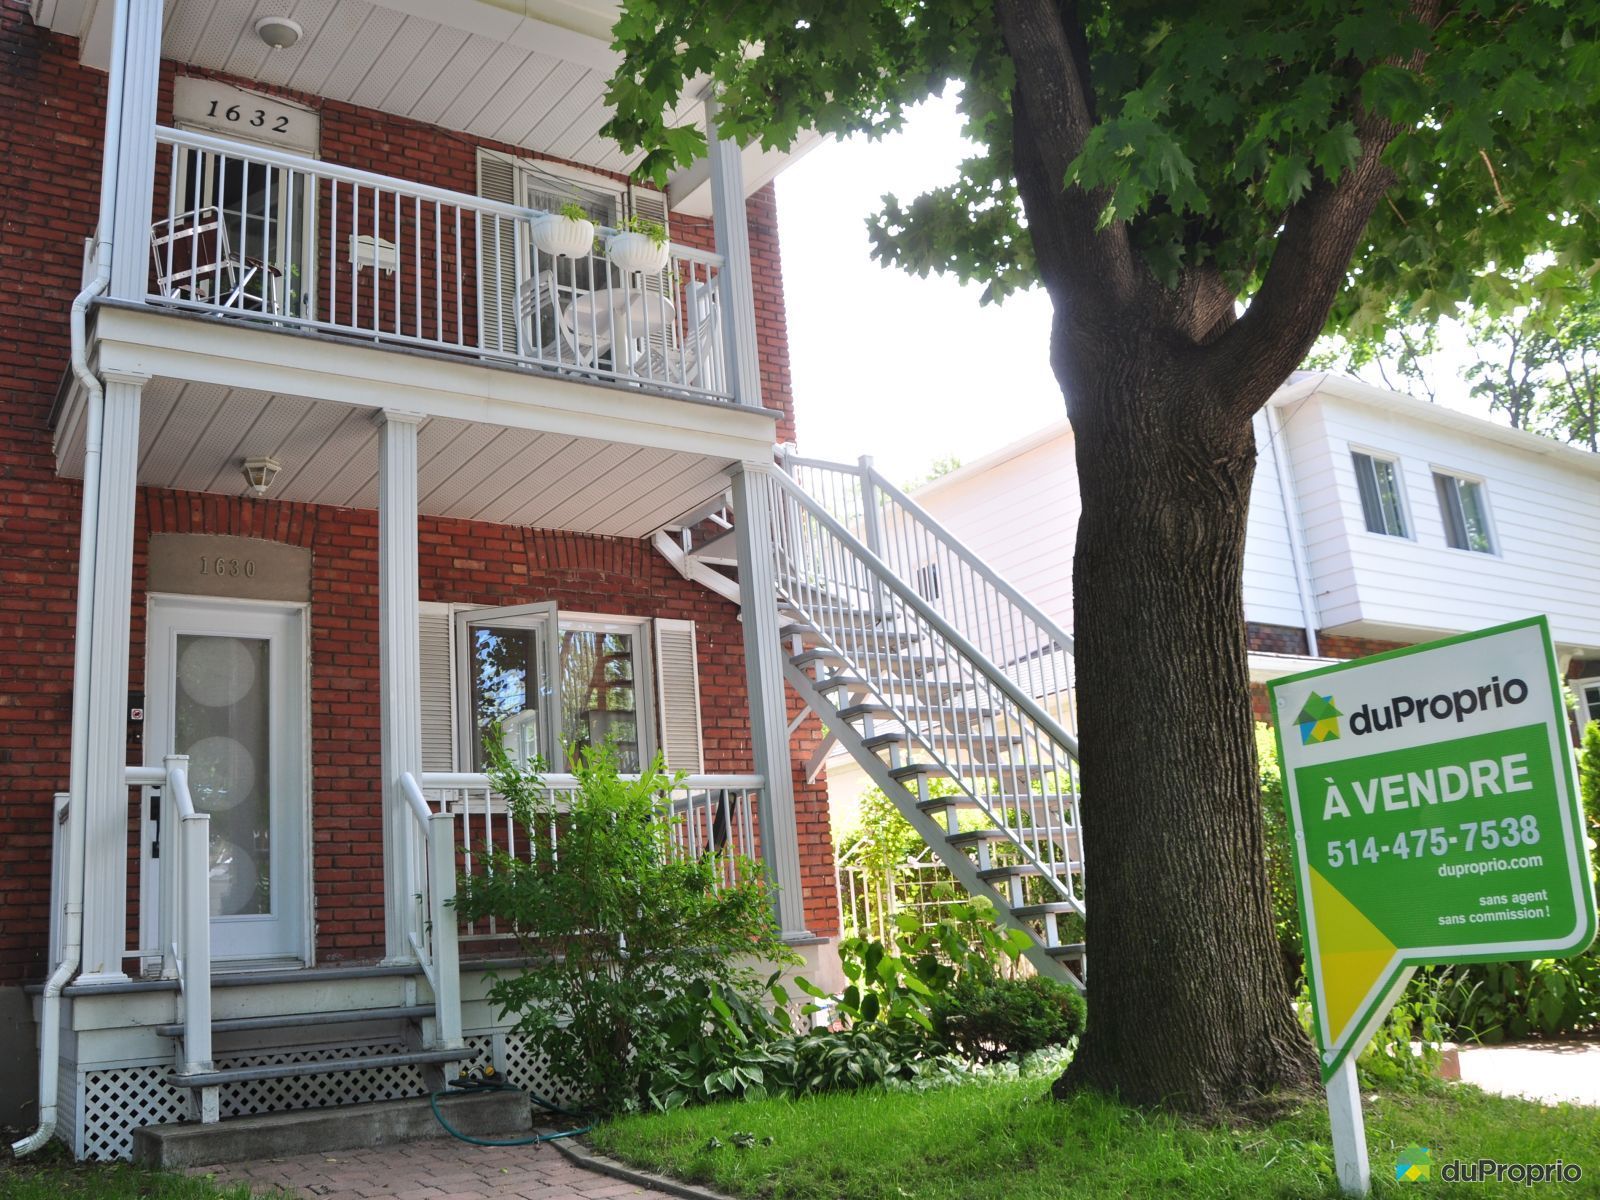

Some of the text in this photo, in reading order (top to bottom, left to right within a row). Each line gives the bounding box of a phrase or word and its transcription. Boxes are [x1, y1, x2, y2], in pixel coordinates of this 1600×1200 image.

[206, 100, 289, 133] 1632
[200, 556, 256, 577] 1630
[1349, 676, 1528, 735] duProprio
[1322, 752, 1534, 821] À VENDRE
[1327, 814, 1541, 868] 514-475-7538
[1438, 855, 1542, 877] duproprio.com
[1479, 889, 1548, 907] sans agent
[1438, 914, 1466, 925] sans
